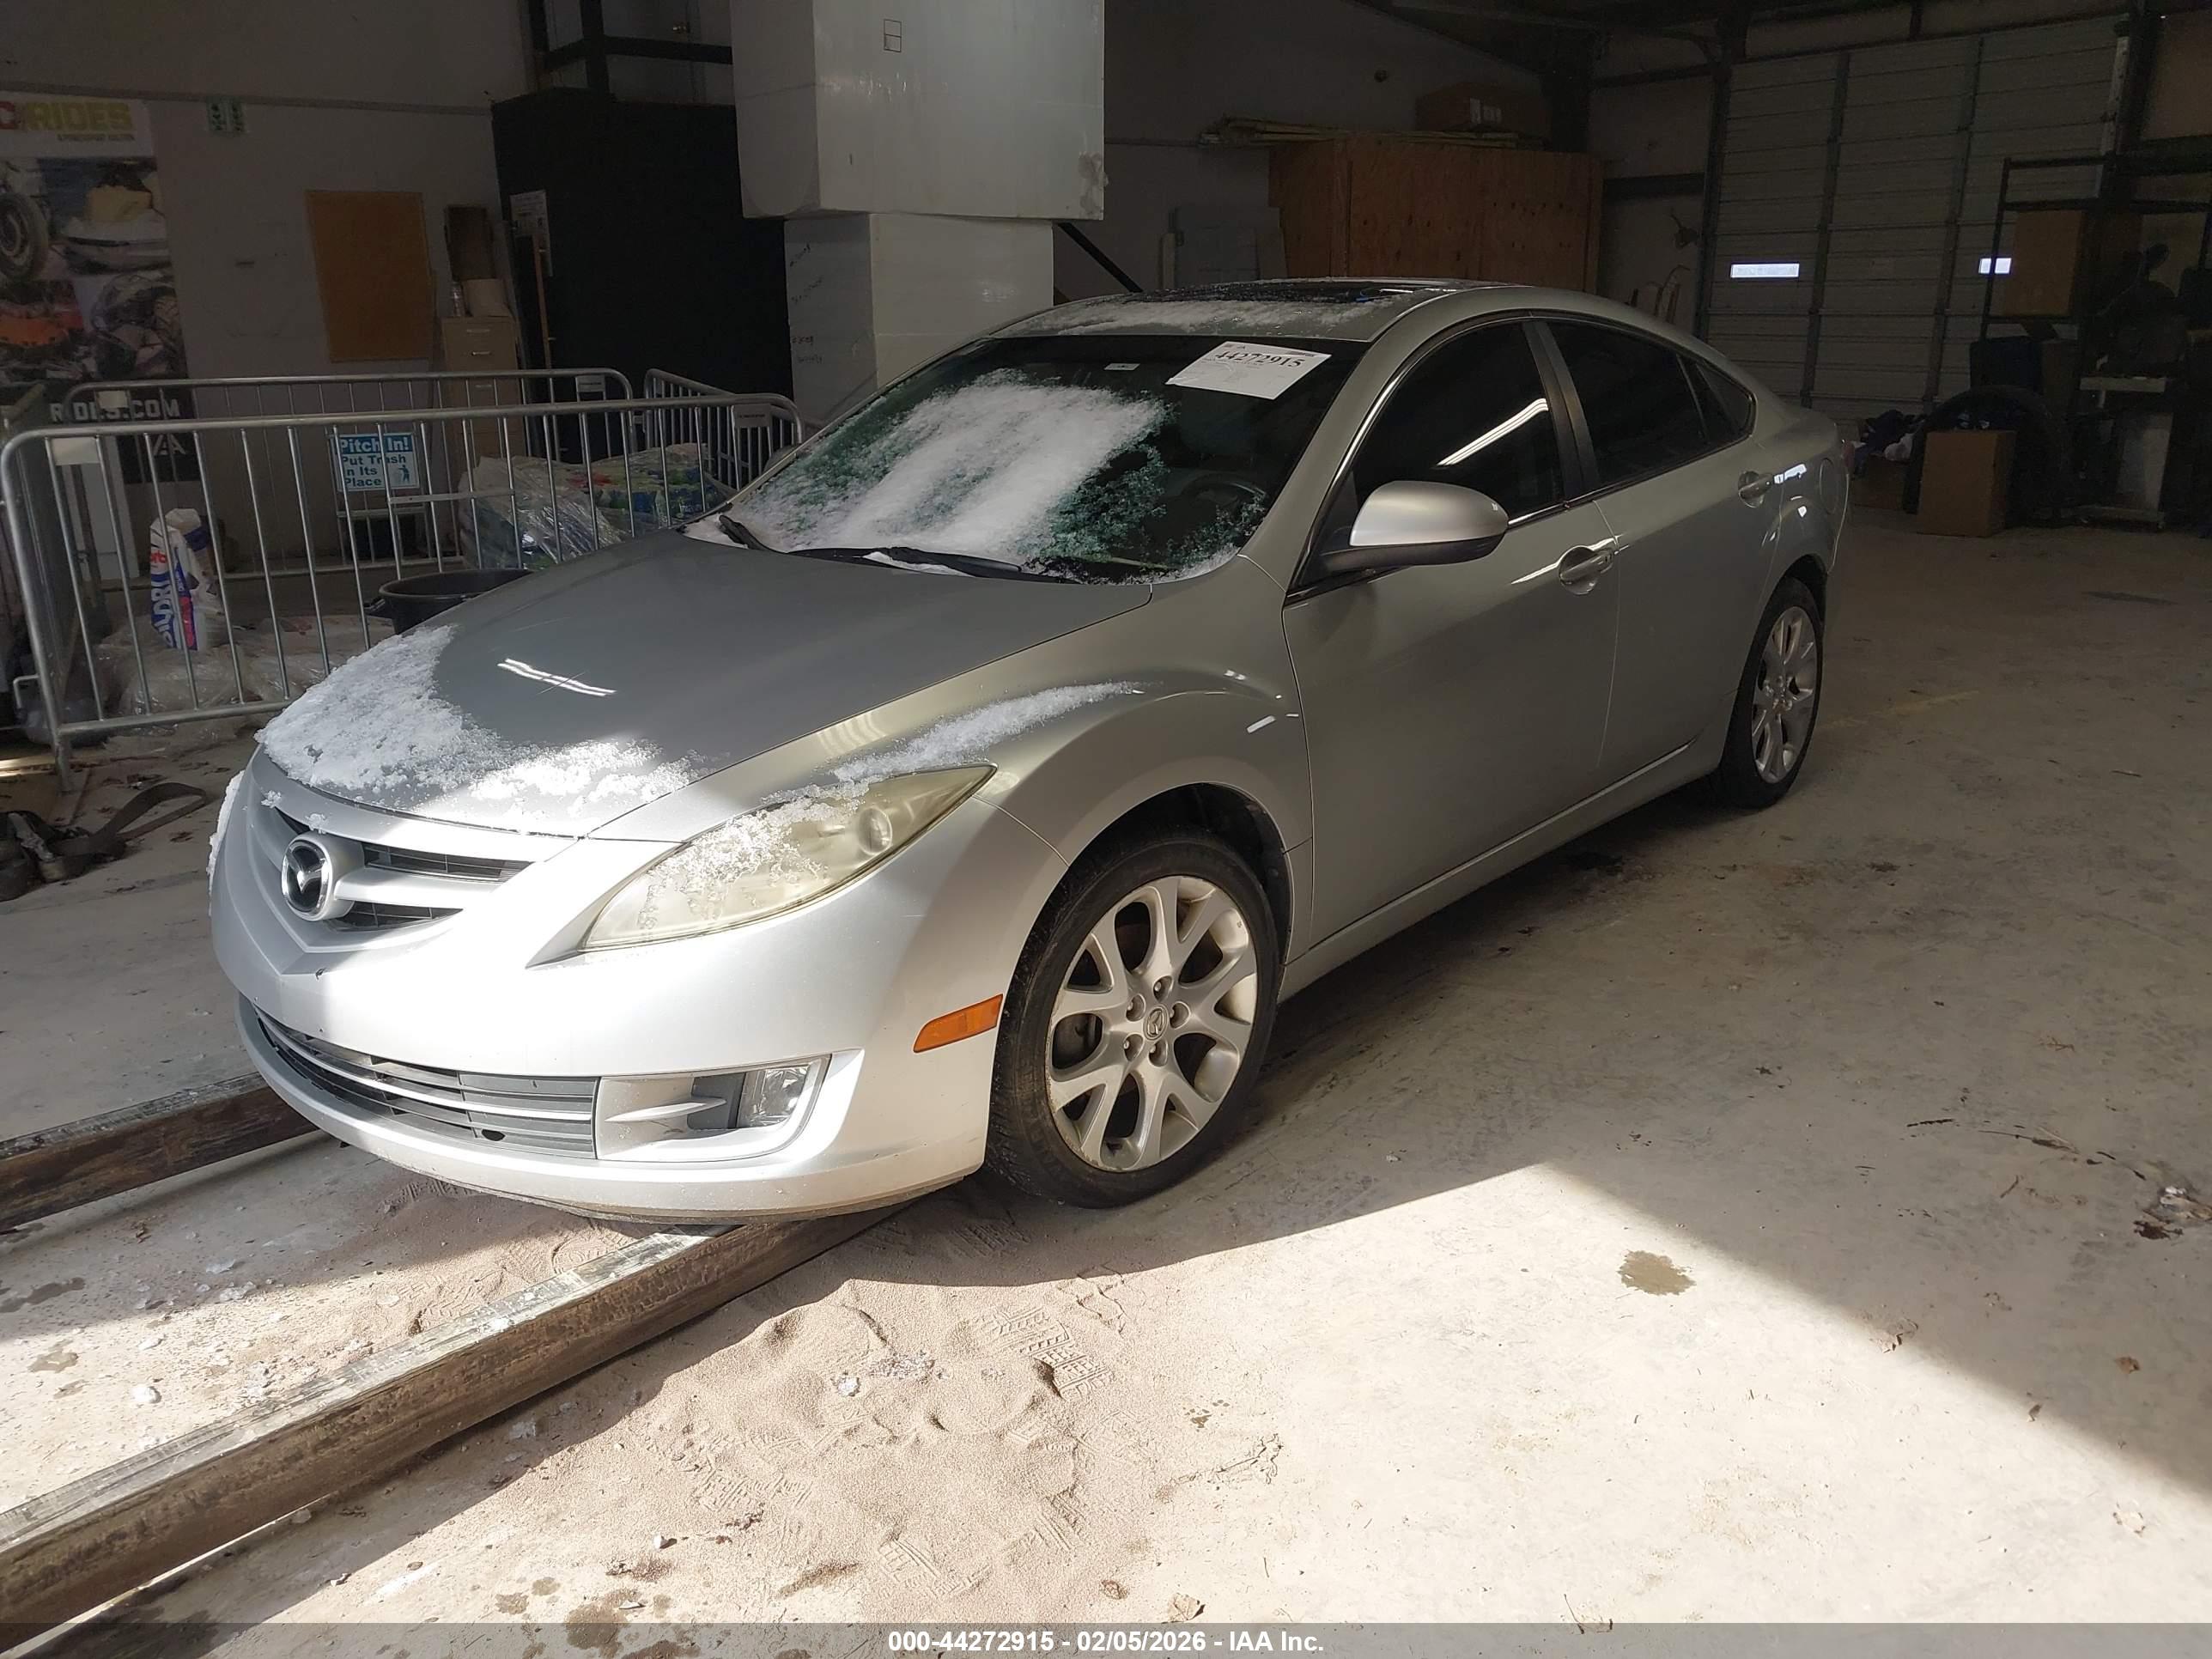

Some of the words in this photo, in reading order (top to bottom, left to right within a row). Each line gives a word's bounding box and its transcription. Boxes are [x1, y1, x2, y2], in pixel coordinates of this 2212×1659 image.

[1215, 350, 1305, 368] 44272915
[341, 438, 380, 453] Pitch
[387, 437, 409, 452] In!
[343, 456, 364, 466] Put
[360, 466, 378, 476] Its
[344, 477, 382, 488] Place
